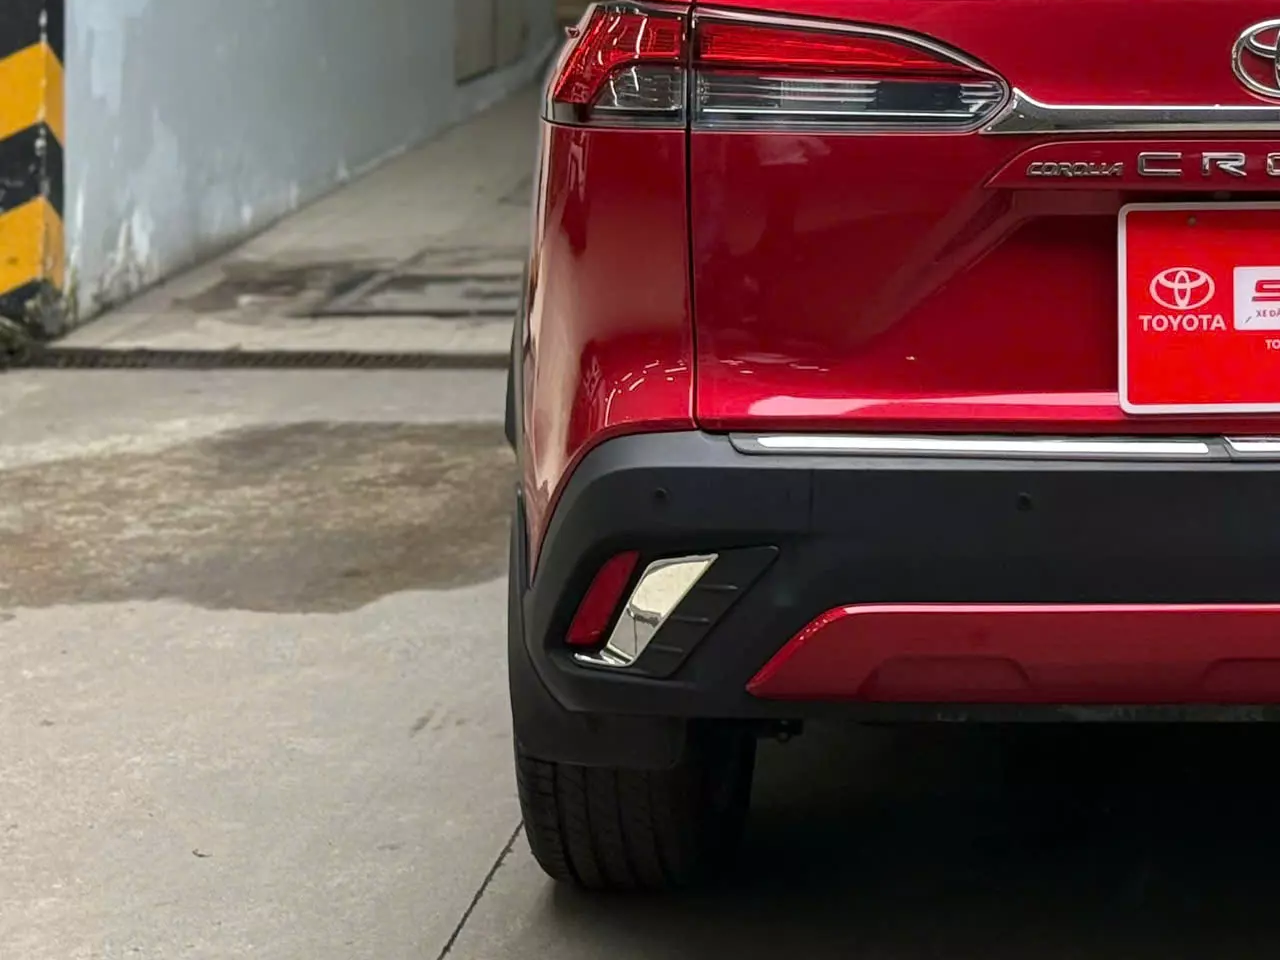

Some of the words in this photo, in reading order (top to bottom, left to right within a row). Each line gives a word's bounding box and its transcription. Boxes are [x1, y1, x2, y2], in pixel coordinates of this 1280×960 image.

[1026, 161, 1125, 177] COROLLA
[1256, 309, 1268, 318] XE
[1138, 314, 1227, 332] TOYOTA
